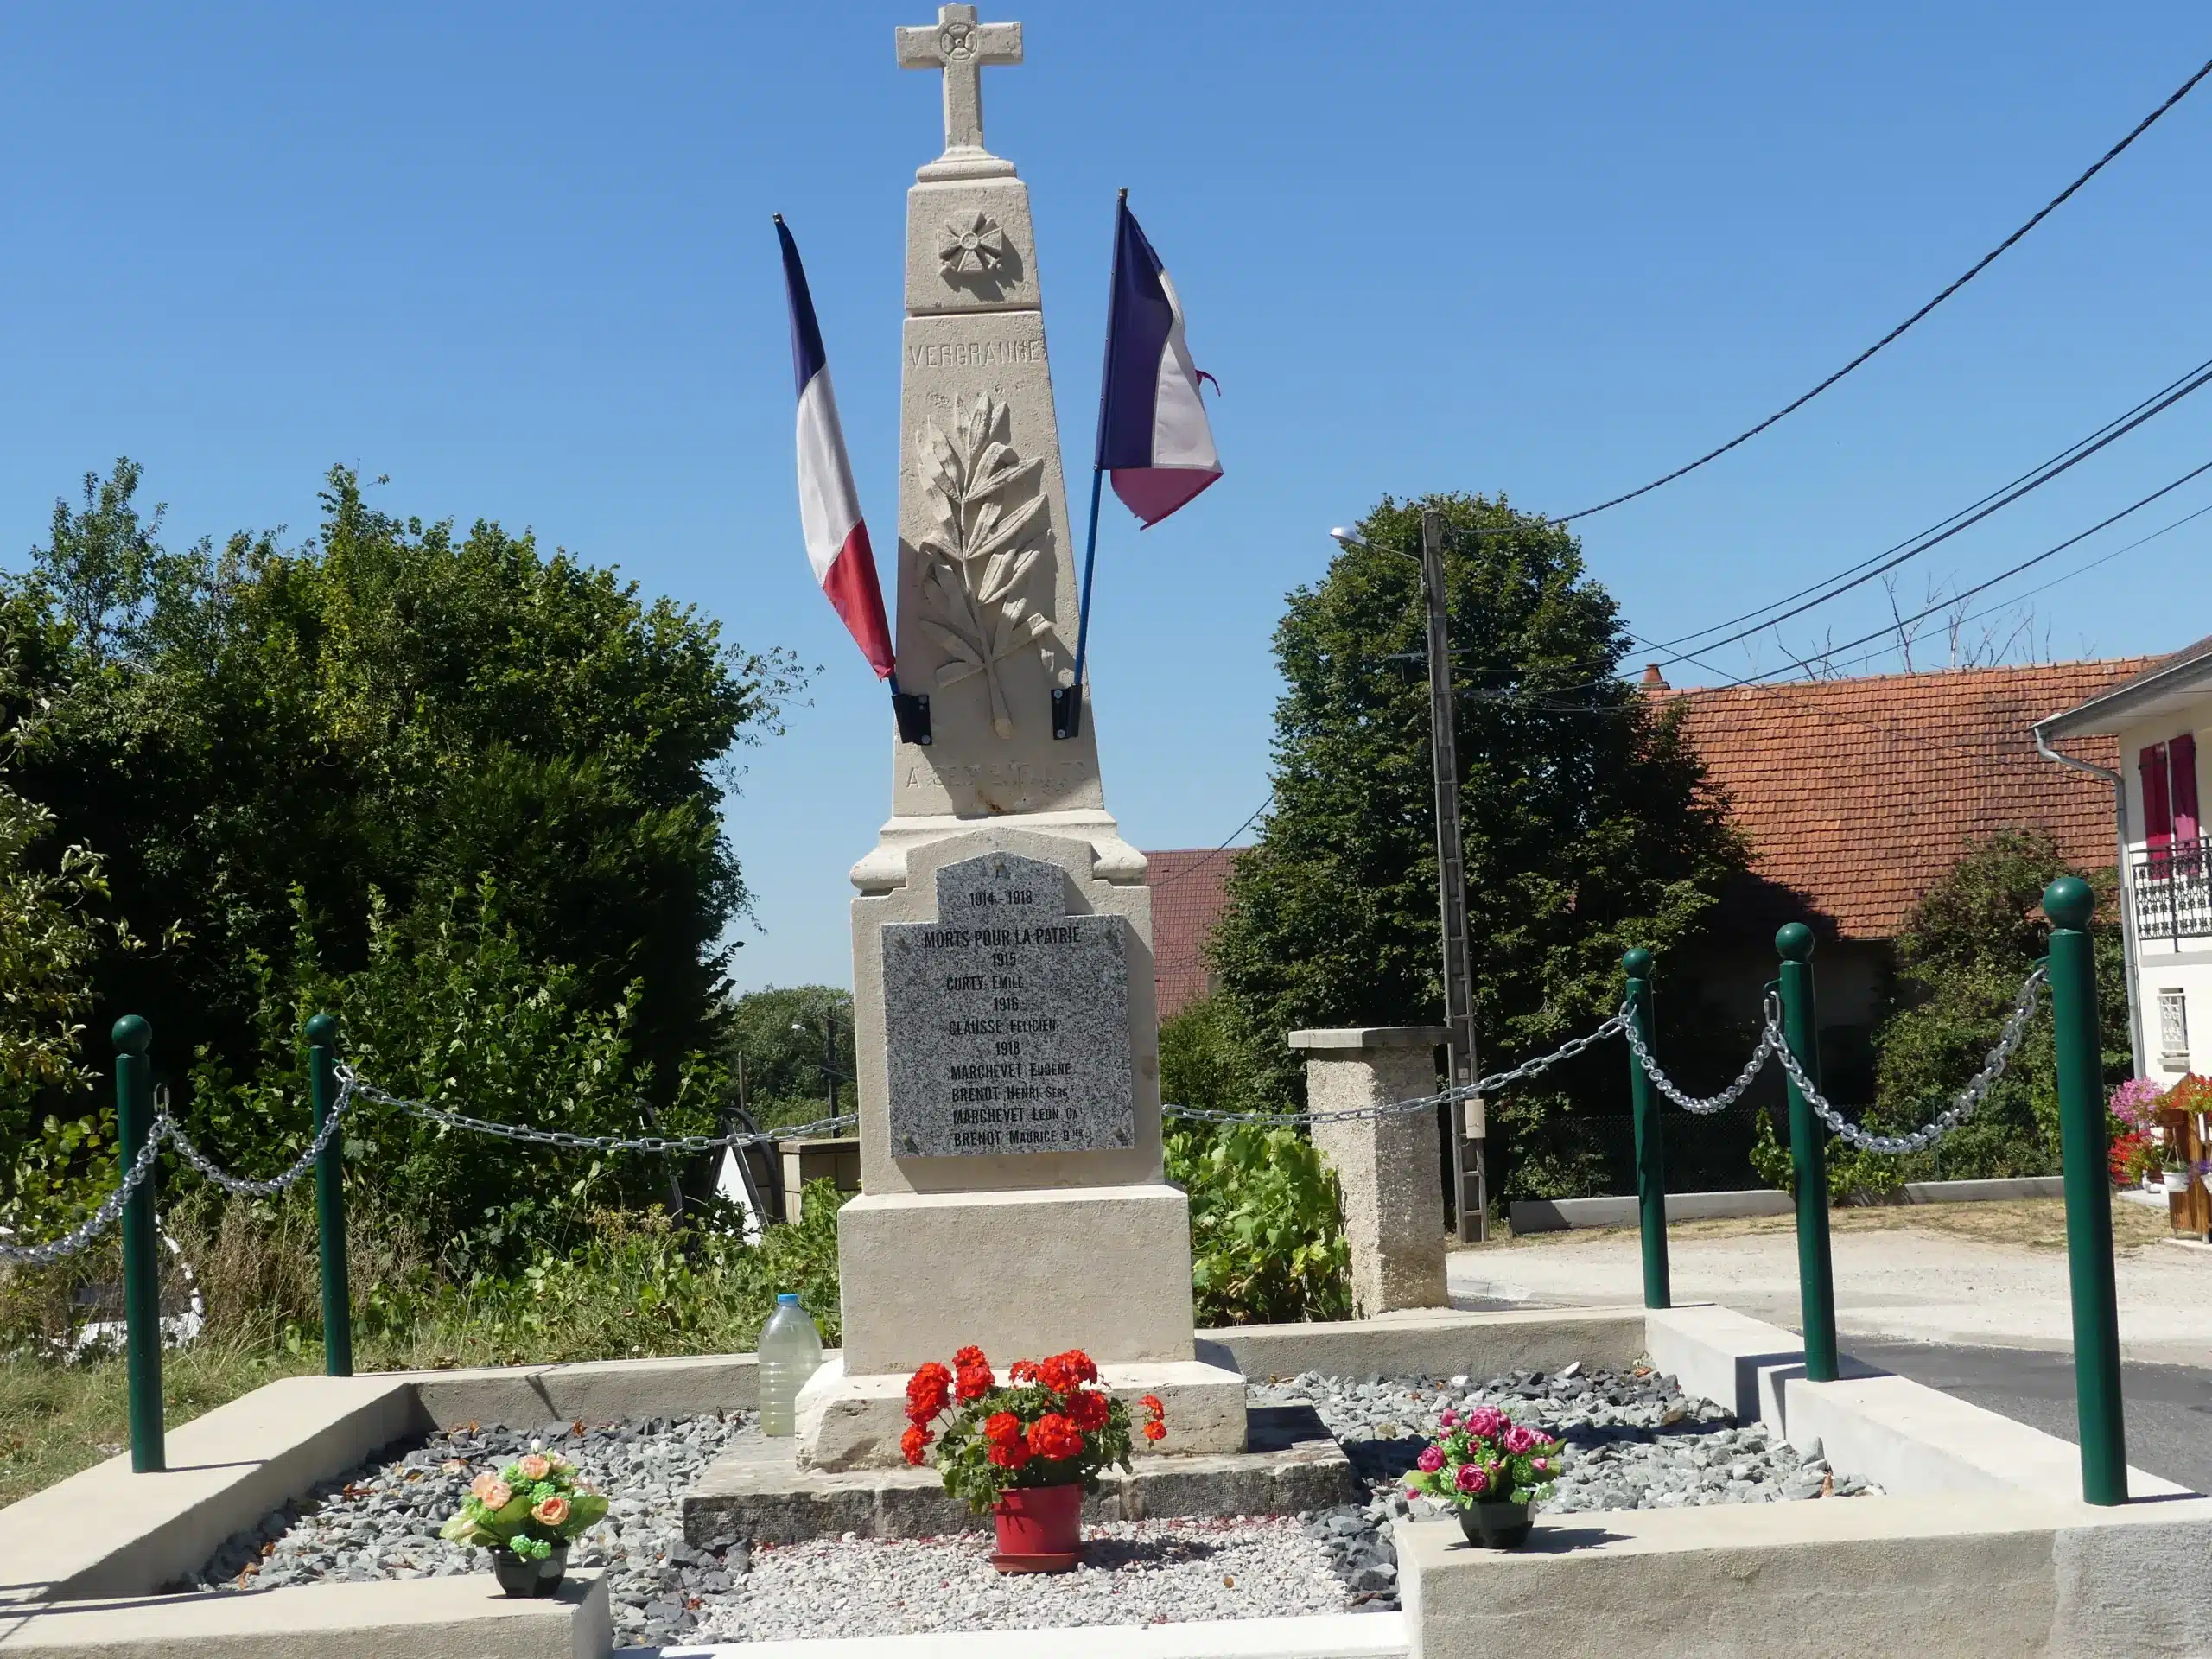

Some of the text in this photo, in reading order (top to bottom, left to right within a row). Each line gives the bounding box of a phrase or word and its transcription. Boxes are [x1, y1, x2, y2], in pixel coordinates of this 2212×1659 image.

[924, 926, 1081, 948] MORTS POUR LA PATRIE
[992, 952, 1016, 967] 1915
[946, 976, 1023, 991] CURTY EMILE
[994, 997, 1019, 1011] 1916
[995, 1041, 1020, 1056] 1918
[951, 1064, 1021, 1080] MARCHEVET
[952, 1086, 999, 1102] BRENOT
[953, 1108, 1023, 1124] MARCHEVET
[954, 1131, 1001, 1147] BRENOT
[1009, 1130, 1056, 1145] MAURICE
